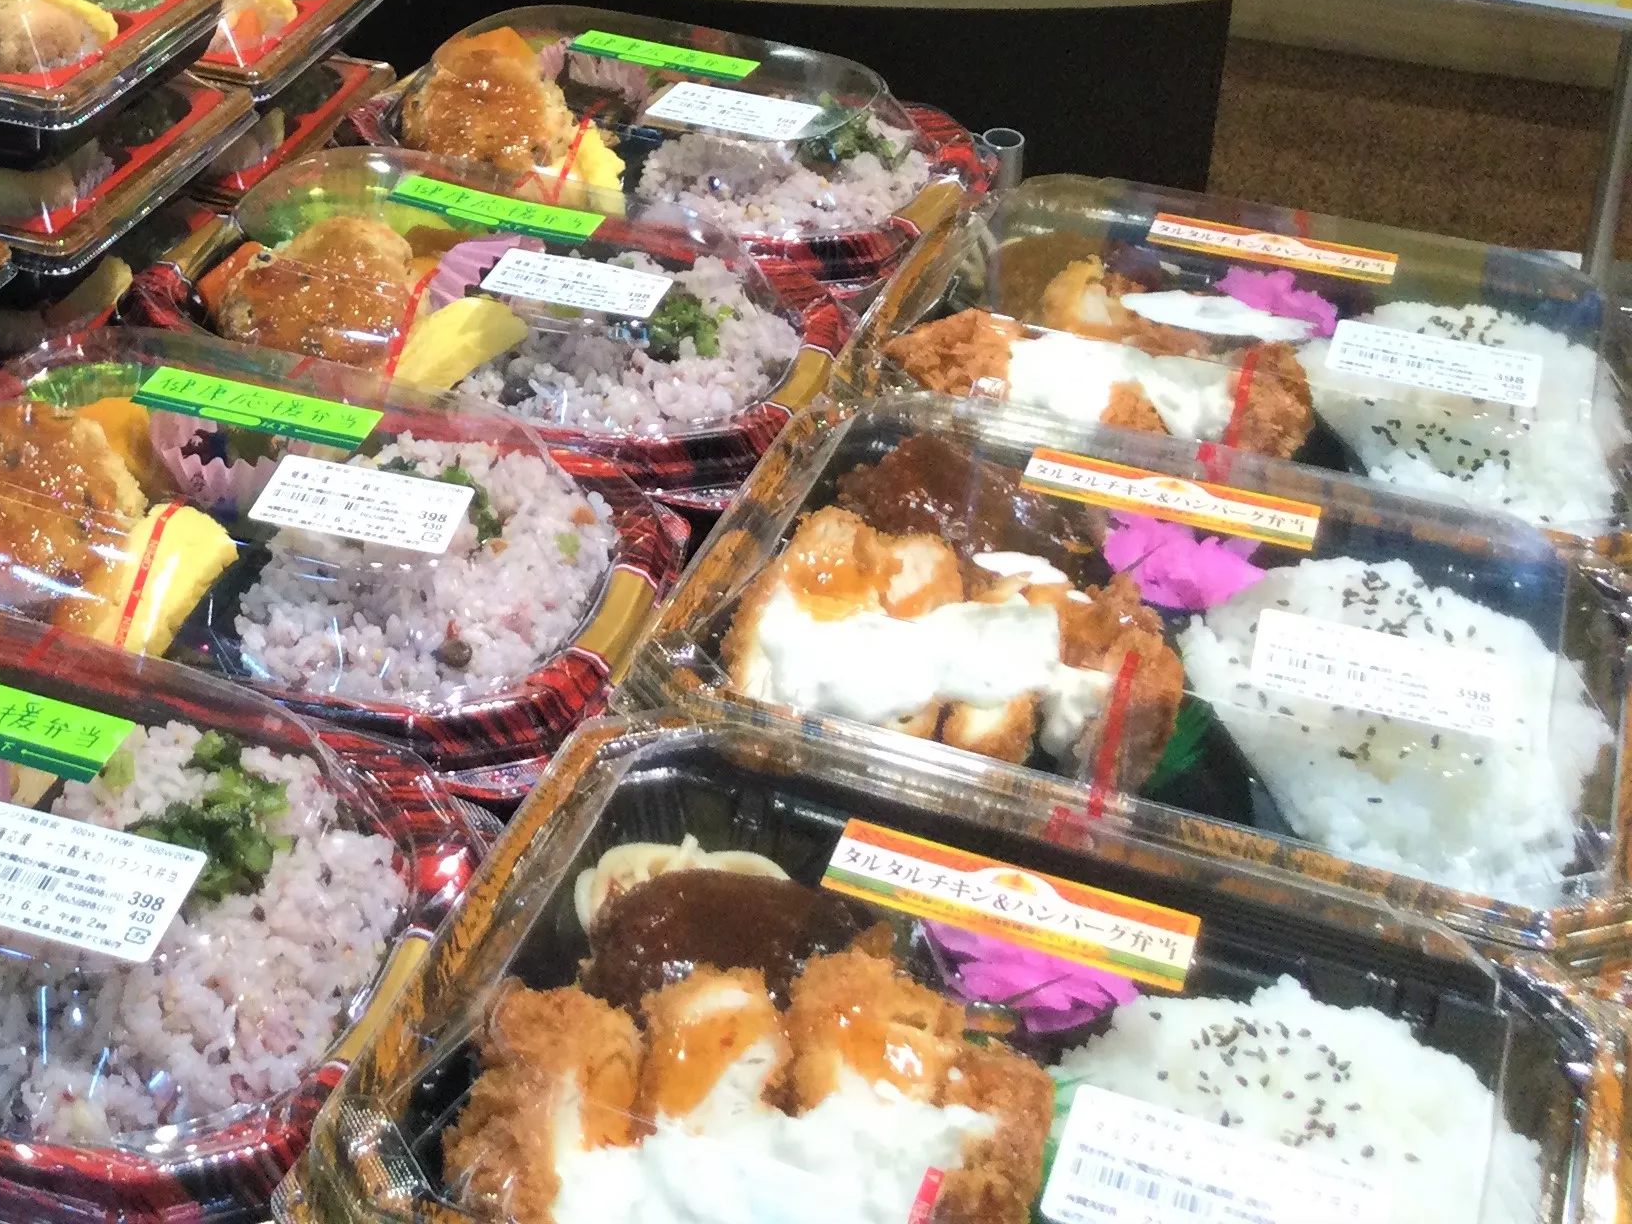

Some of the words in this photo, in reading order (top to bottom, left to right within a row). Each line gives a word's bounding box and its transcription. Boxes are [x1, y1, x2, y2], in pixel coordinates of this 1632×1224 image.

[418, 509, 449, 524] 398
[421, 521, 445, 532] 430
[1455, 687, 1492, 703] 398
[127, 890, 166, 913] 398
[842, 846, 1179, 961] タルタルチキン&ハンバーグ弁当
[129, 909, 157, 926] 430
